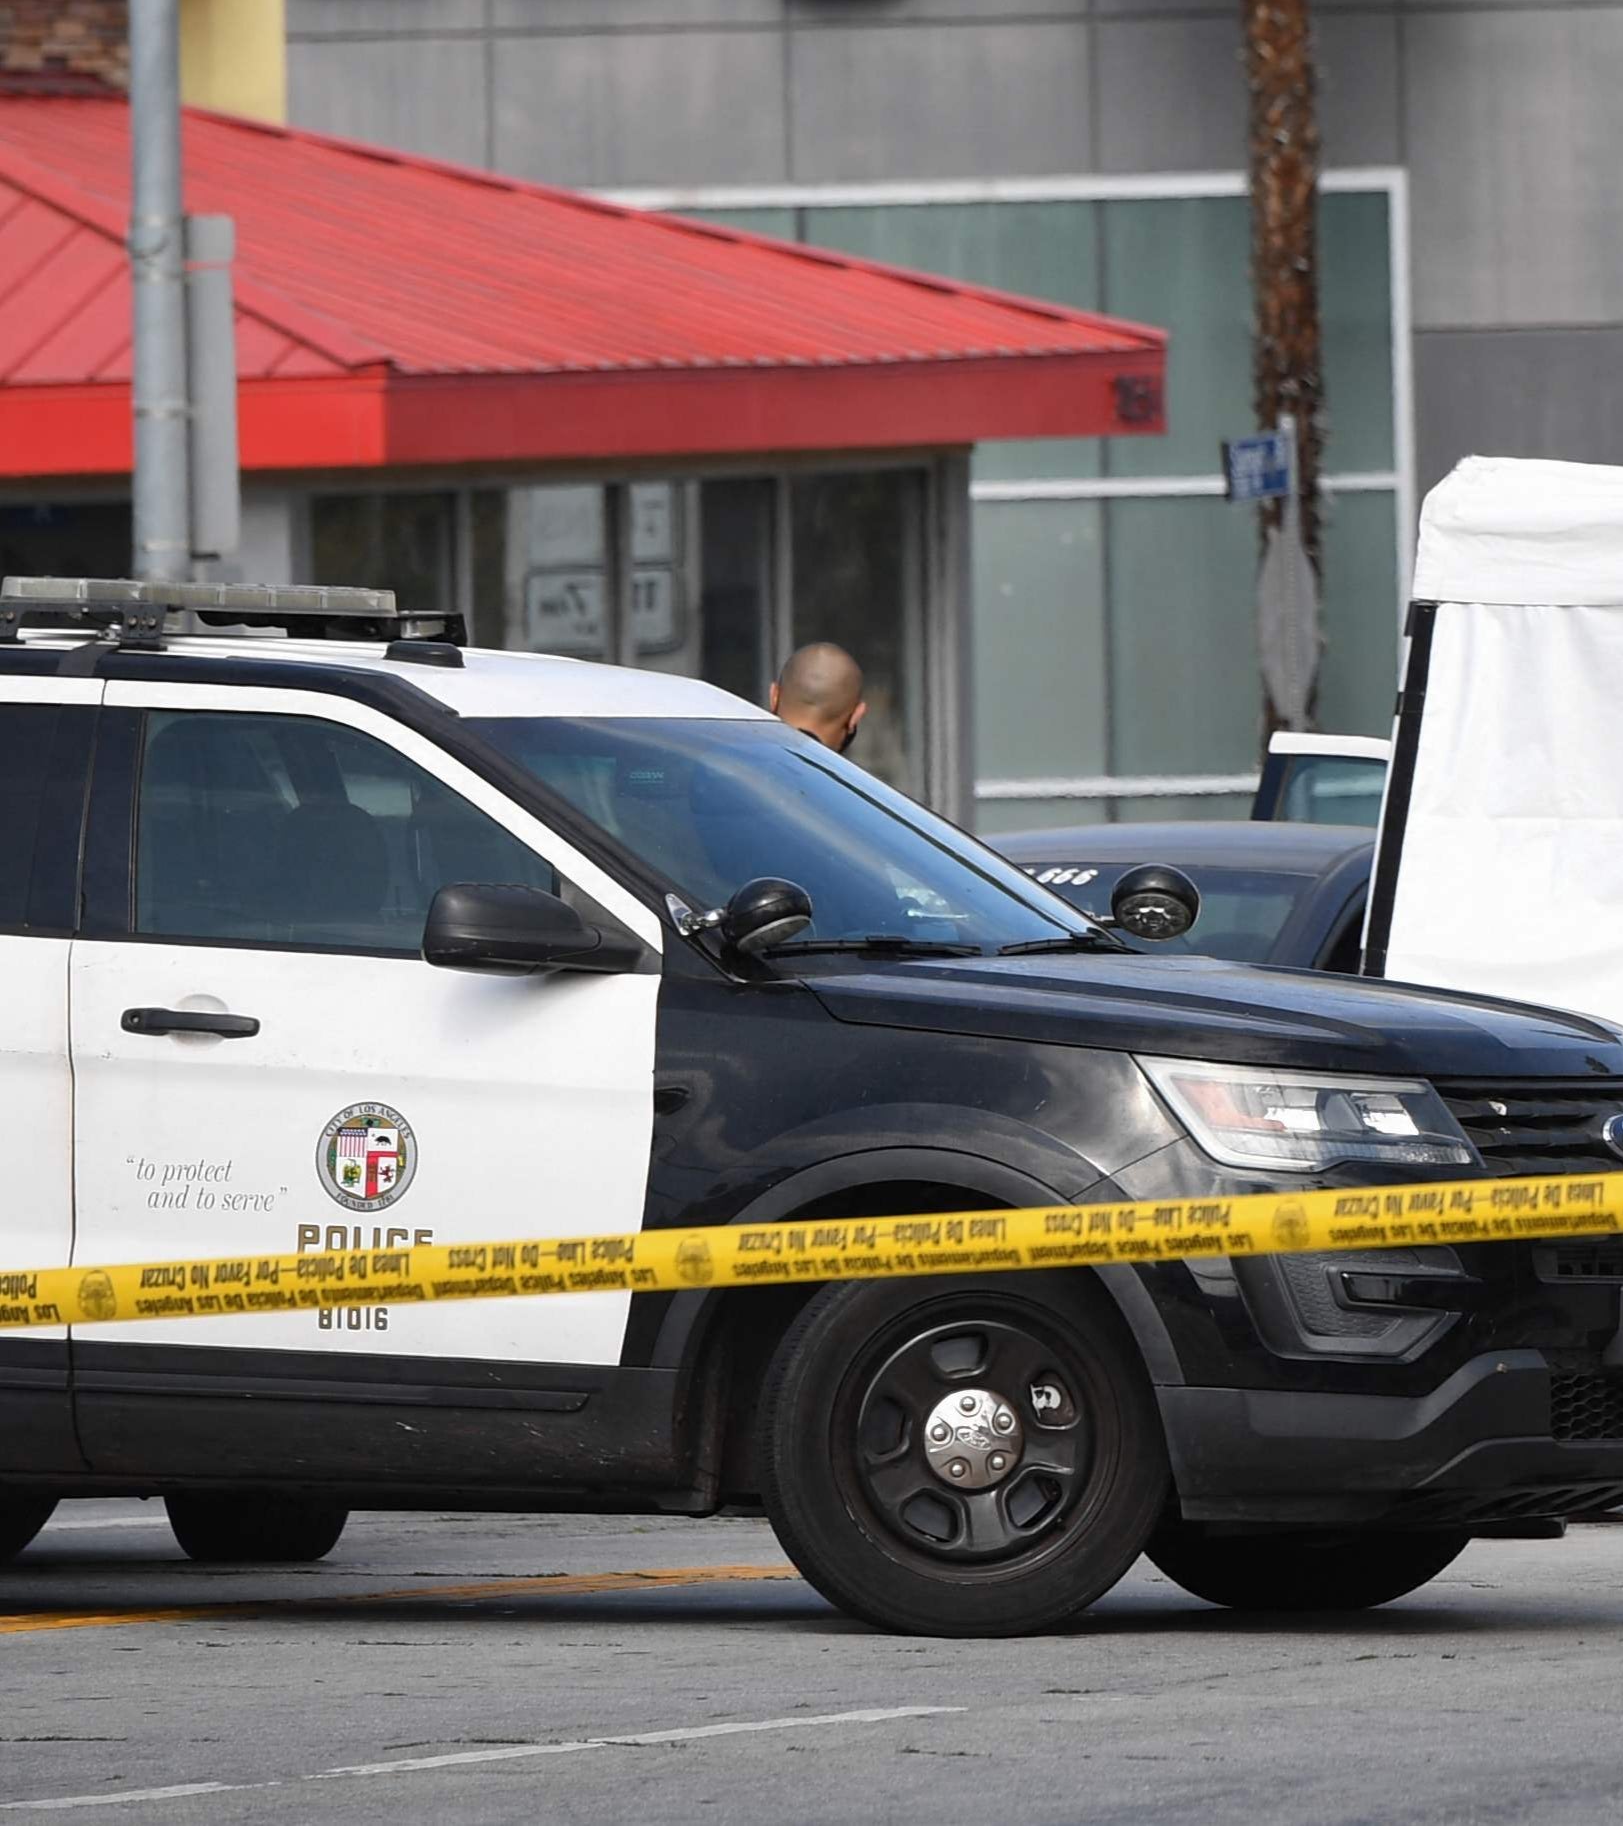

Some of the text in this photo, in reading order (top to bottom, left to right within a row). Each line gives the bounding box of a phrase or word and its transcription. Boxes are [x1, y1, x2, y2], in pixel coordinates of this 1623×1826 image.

[1023, 867, 1098, 885] 666
[359, 1105, 376, 1114] LOS
[378, 1106, 411, 1139] ANGELES
[162, 1159, 232, 1185] protect
[147, 1185, 195, 1210] and
[196, 1186, 215, 1211] to
[1334, 1196, 1379, 1221] Cruzar
[1386, 1194, 1402, 1217] No
[1408, 1192, 1444, 1216] Favor
[1543, 1185, 1561, 1209] De
[1045, 1213, 1082, 1238] Cross
[1089, 1212, 1111, 1234] Not
[1187, 1203, 1232, 1229] Police
[738, 1231, 782, 1256] Cruzar
[788, 1230, 806, 1253] No
[811, 1228, 847, 1252] Favor
[947, 1220, 963, 1245] De
[449, 1247, 486, 1274] Cross
[492, 1246, 515, 1271] Not
[592, 1239, 634, 1265] Police
[140, 1266, 185, 1293] Cruzar
[191, 1265, 209, 1290] No
[215, 1262, 251, 1288] Favor
[350, 1255, 367, 1281] De
[0, 1274, 37, 1300] Polic
[318, 1307, 388, 1331] 81016
